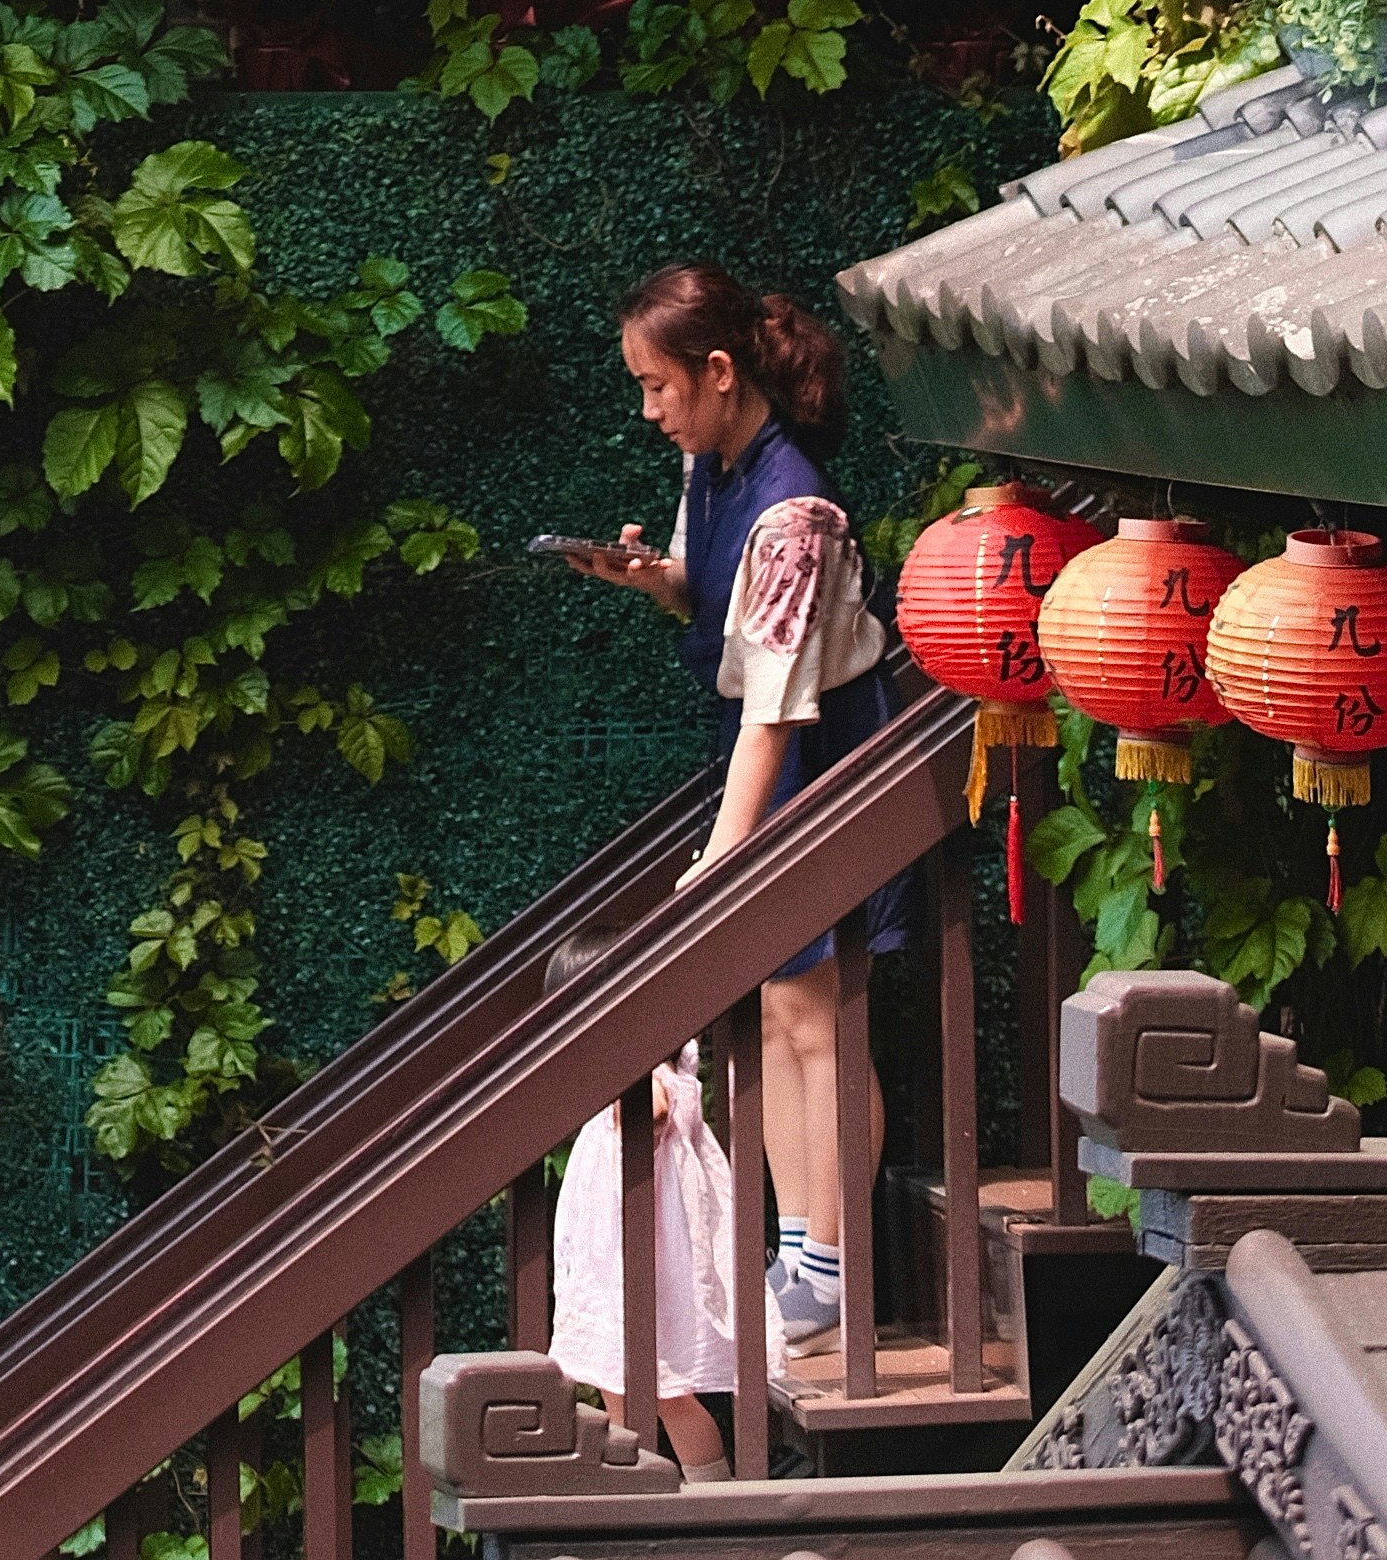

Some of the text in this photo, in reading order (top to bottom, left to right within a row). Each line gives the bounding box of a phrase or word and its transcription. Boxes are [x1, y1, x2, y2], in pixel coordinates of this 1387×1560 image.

[993, 533, 1059, 685] 九份
[1160, 567, 1211, 702] 九份
[1329, 604, 1383, 737] 九份
